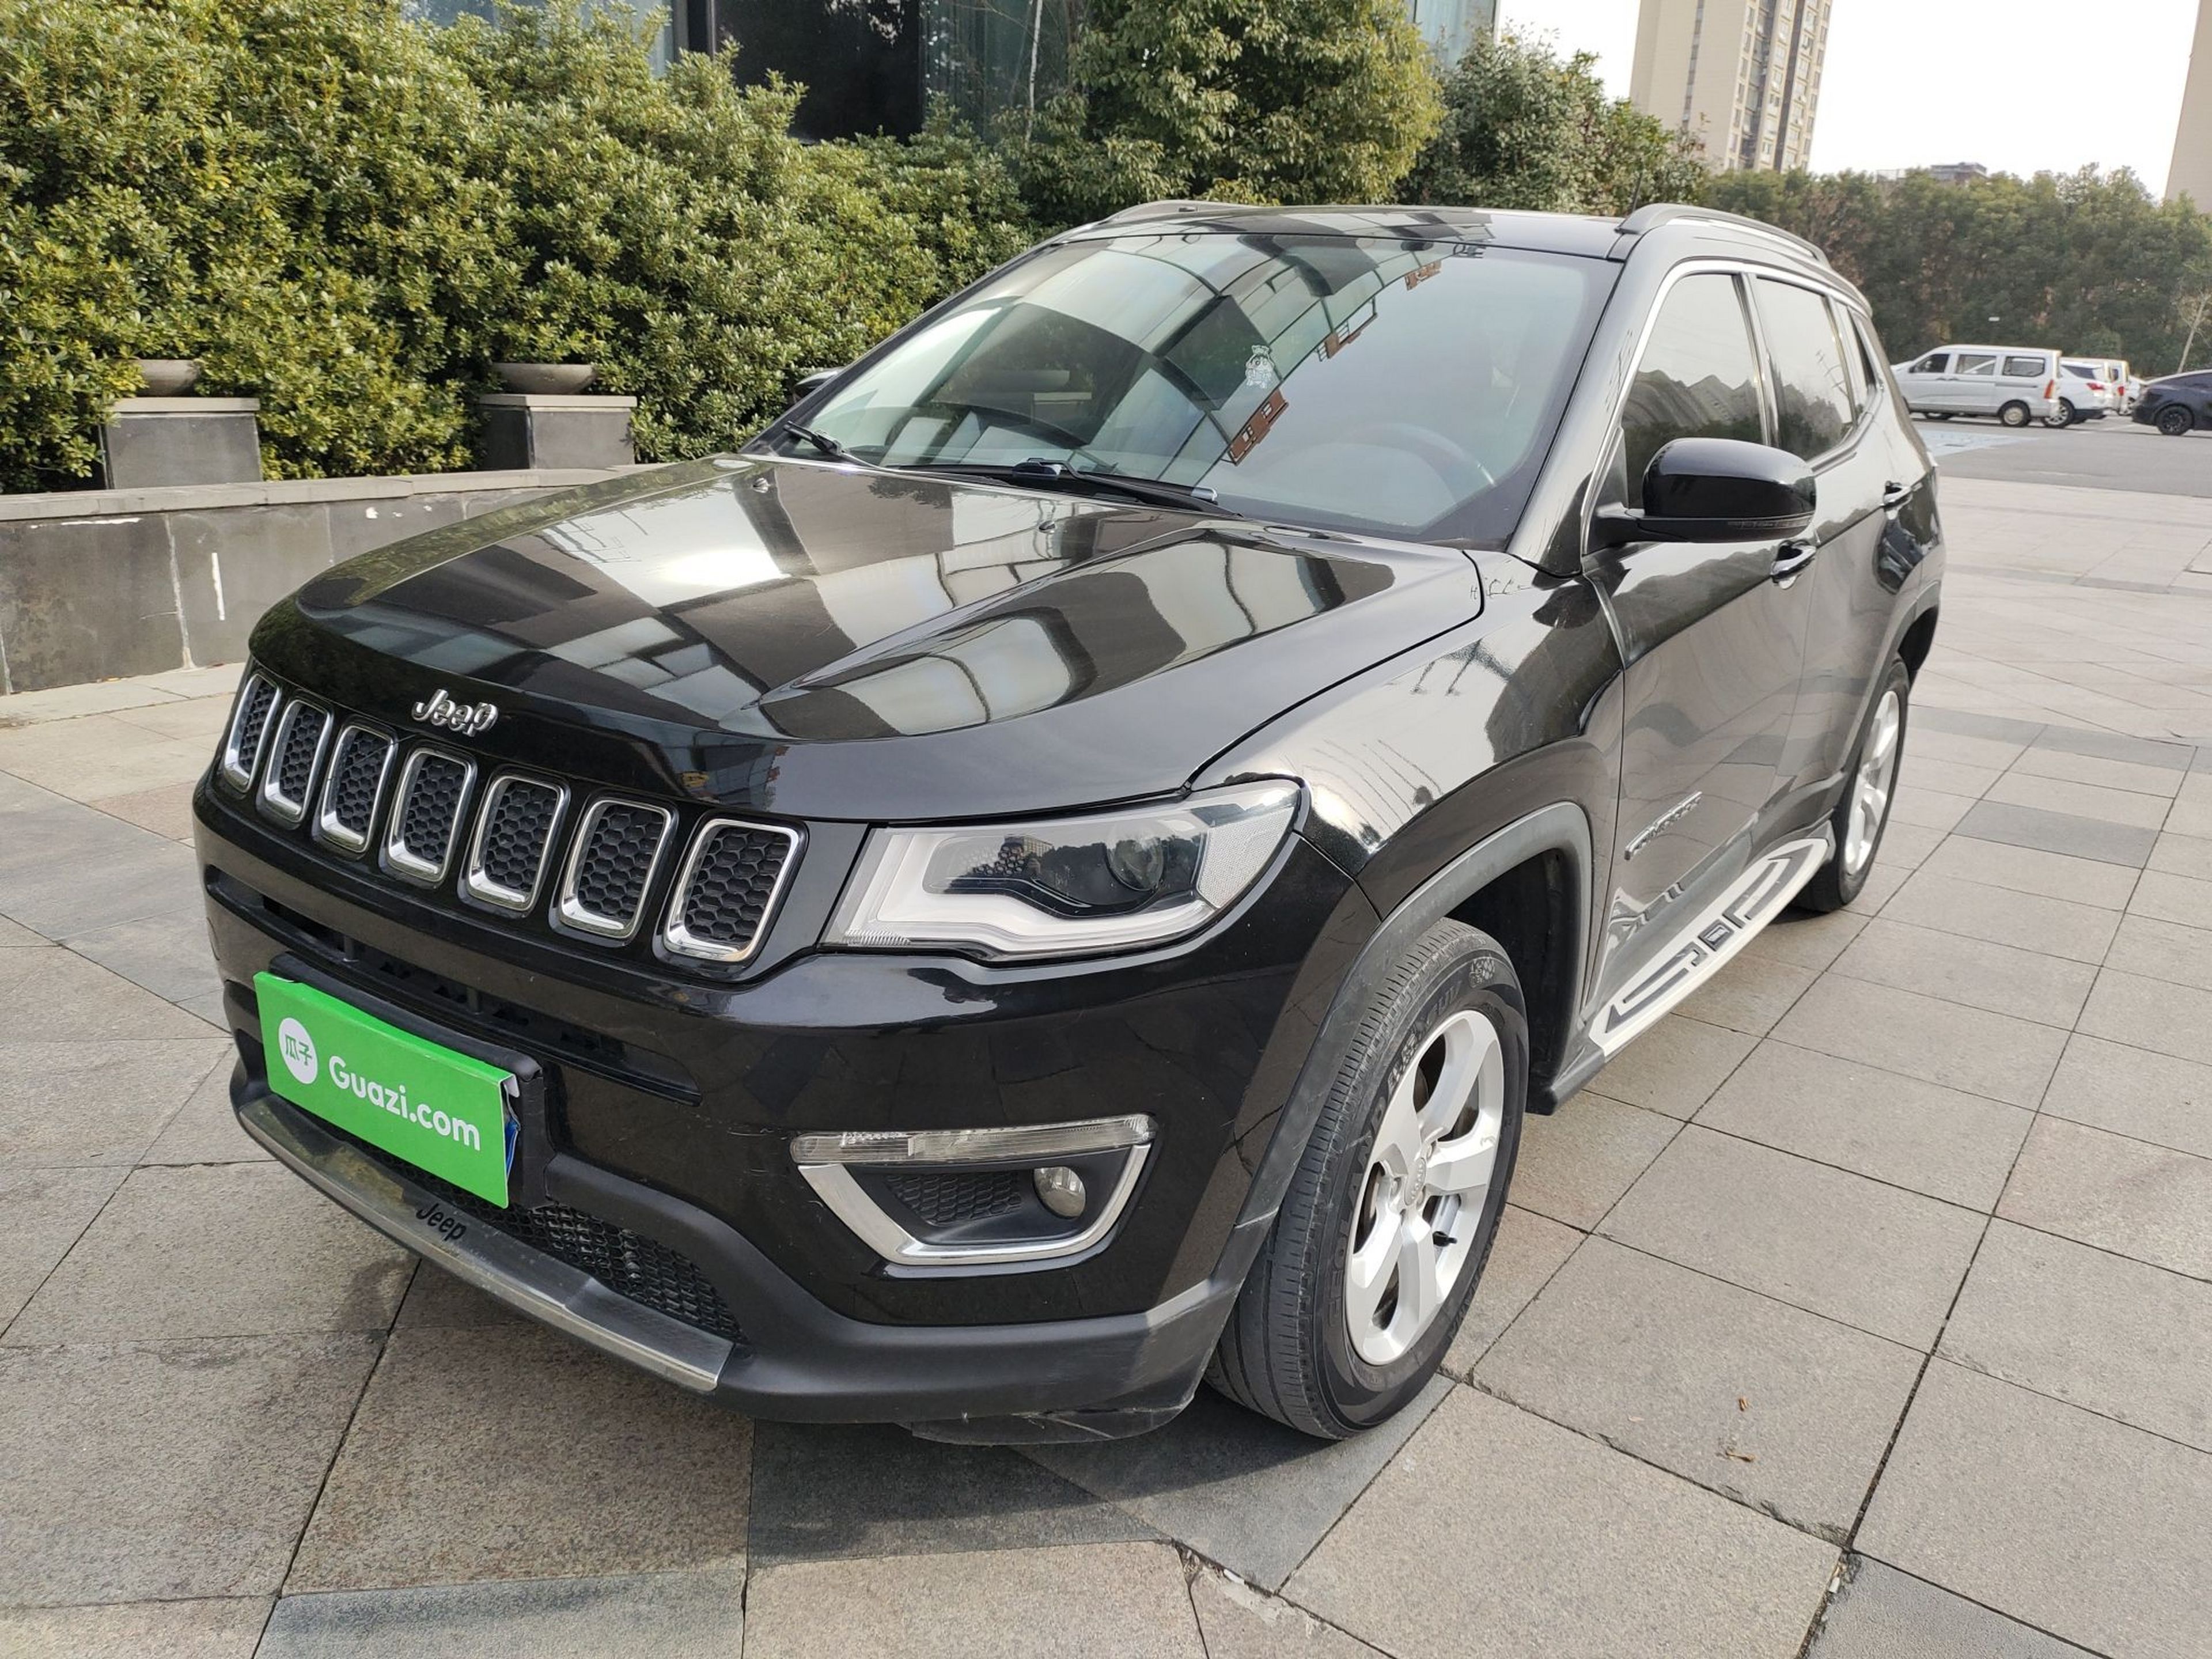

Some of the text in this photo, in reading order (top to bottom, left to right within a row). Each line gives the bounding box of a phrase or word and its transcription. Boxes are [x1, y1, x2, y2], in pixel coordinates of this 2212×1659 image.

[411, 689, 498, 737] Jeep
[285, 1034, 313, 1066] 瓜子
[329, 1055, 480, 1152] Guazi.com
[416, 1203, 467, 1241] Jeep
